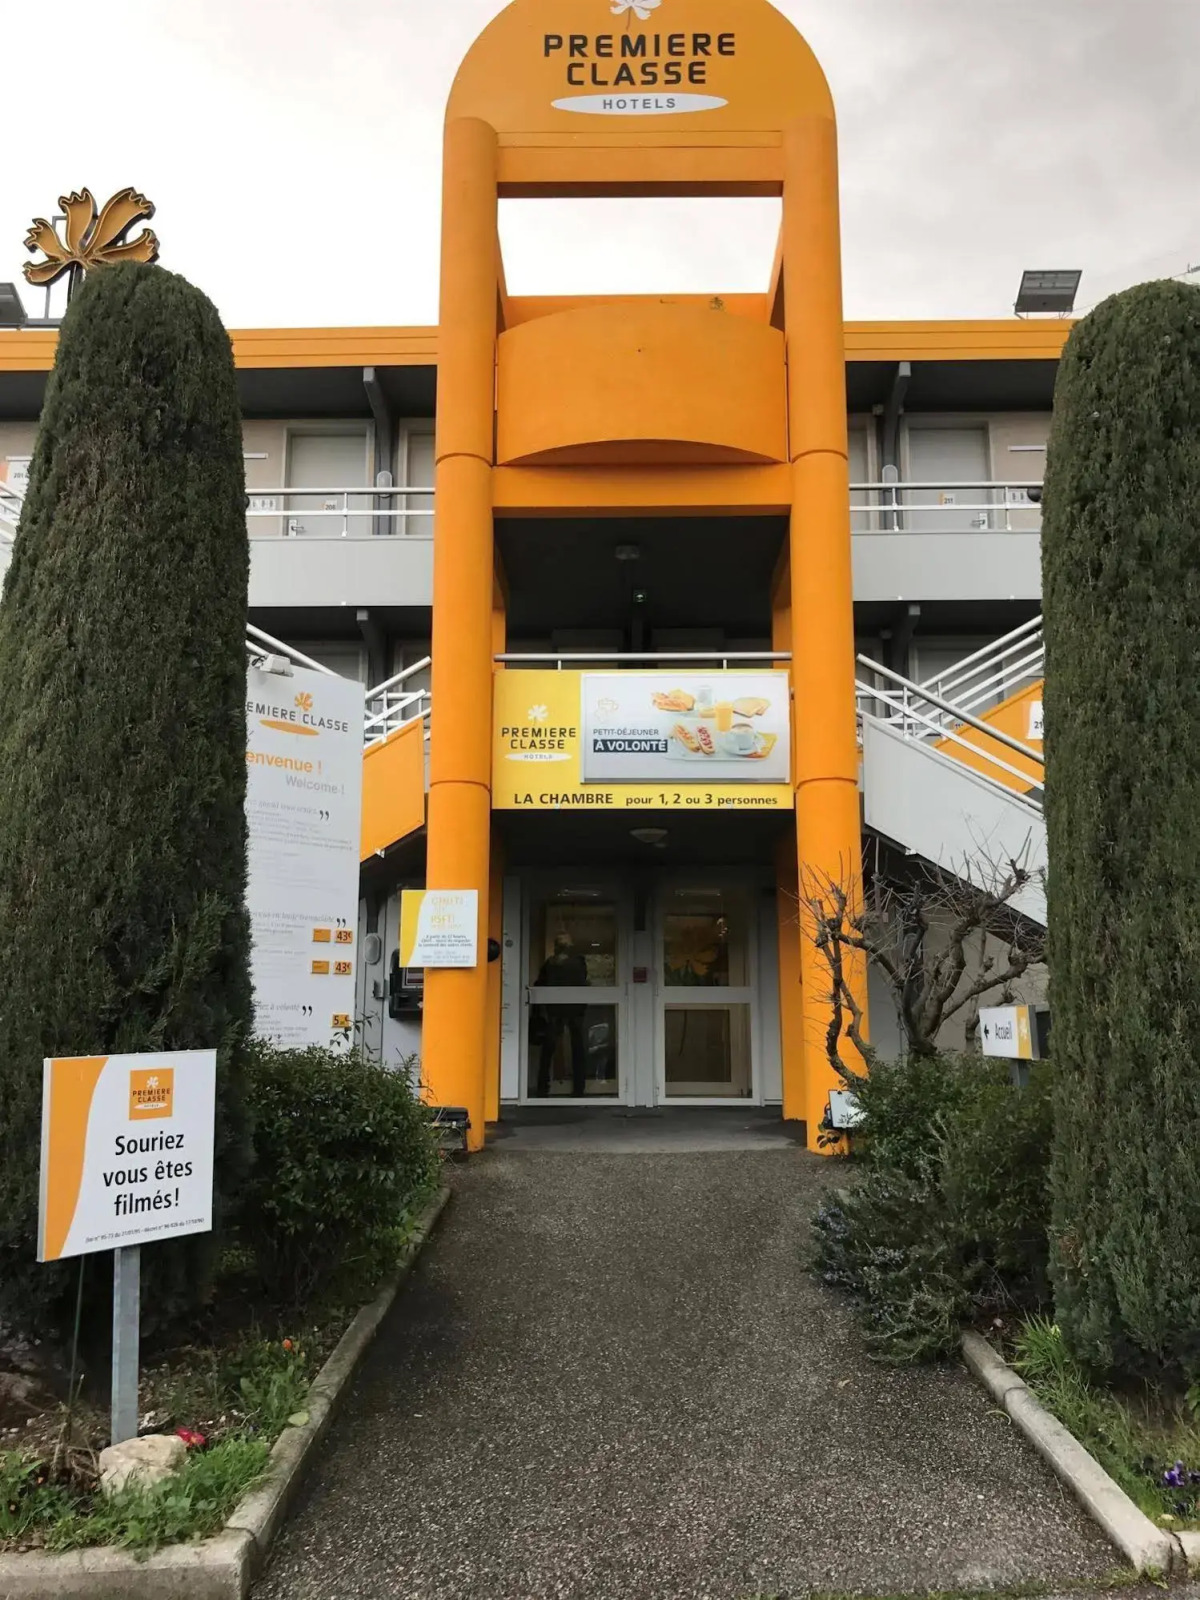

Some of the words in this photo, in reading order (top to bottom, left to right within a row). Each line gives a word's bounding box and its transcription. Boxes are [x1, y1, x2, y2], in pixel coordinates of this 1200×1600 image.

[543, 33, 736, 57] PREMIERE
[566, 61, 707, 86] CLASSE
[602, 98, 676, 110] HOTELS
[246, 701, 296, 722] EMIERE
[302, 714, 349, 732] CLASSE
[501, 727, 576, 738] PREMIERE
[593, 727, 659, 736] PETIT-DÉJEUNER
[510, 739, 565, 749] CLASSE
[605, 739, 666, 751] VOLONTÉ
[246, 752, 313, 773] envenue
[285, 775, 338, 794] Welcome
[514, 793, 534, 804] LA
[539, 793, 613, 804] CHAMBRE
[625, 796, 653, 806] pour
[658, 793, 669, 806] 1,
[673, 793, 681, 804] 2
[685, 795, 700, 804] ou
[704, 793, 713, 805] 3
[717, 795, 778, 806] personnes
[994, 1021, 1012, 1040] Accueil
[132, 1088, 171, 1097] PREMIERE
[137, 1095, 166, 1103] CLASSE
[114, 1131, 185, 1156] Souriez
[103, 1166, 148, 1187] vous
[154, 1161, 193, 1180] êtes
[113, 1188, 180, 1216] filmés!
